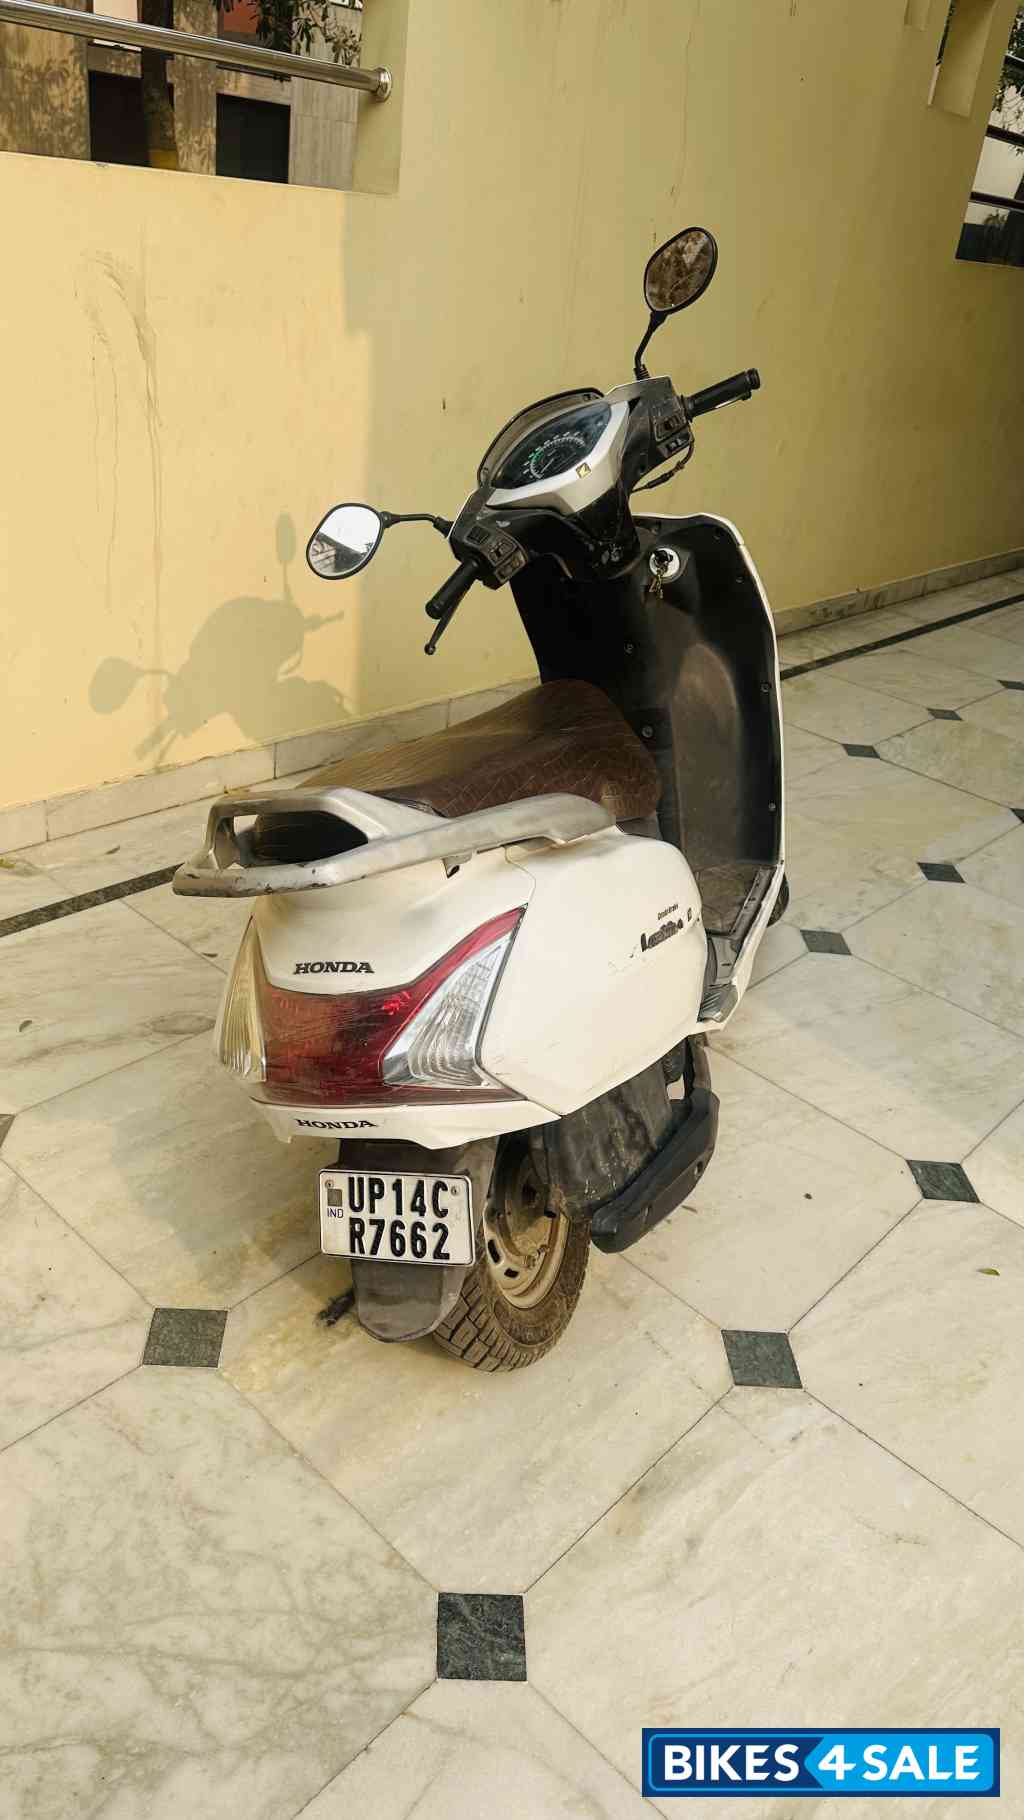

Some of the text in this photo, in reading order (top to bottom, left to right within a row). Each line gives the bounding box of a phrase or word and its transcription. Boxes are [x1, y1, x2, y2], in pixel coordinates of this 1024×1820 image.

[293, 961, 374, 975] HONDA
[295, 1119, 376, 1129] HONDA
[327, 1208, 344, 1219] IND
[349, 1217, 450, 1260] R7662
